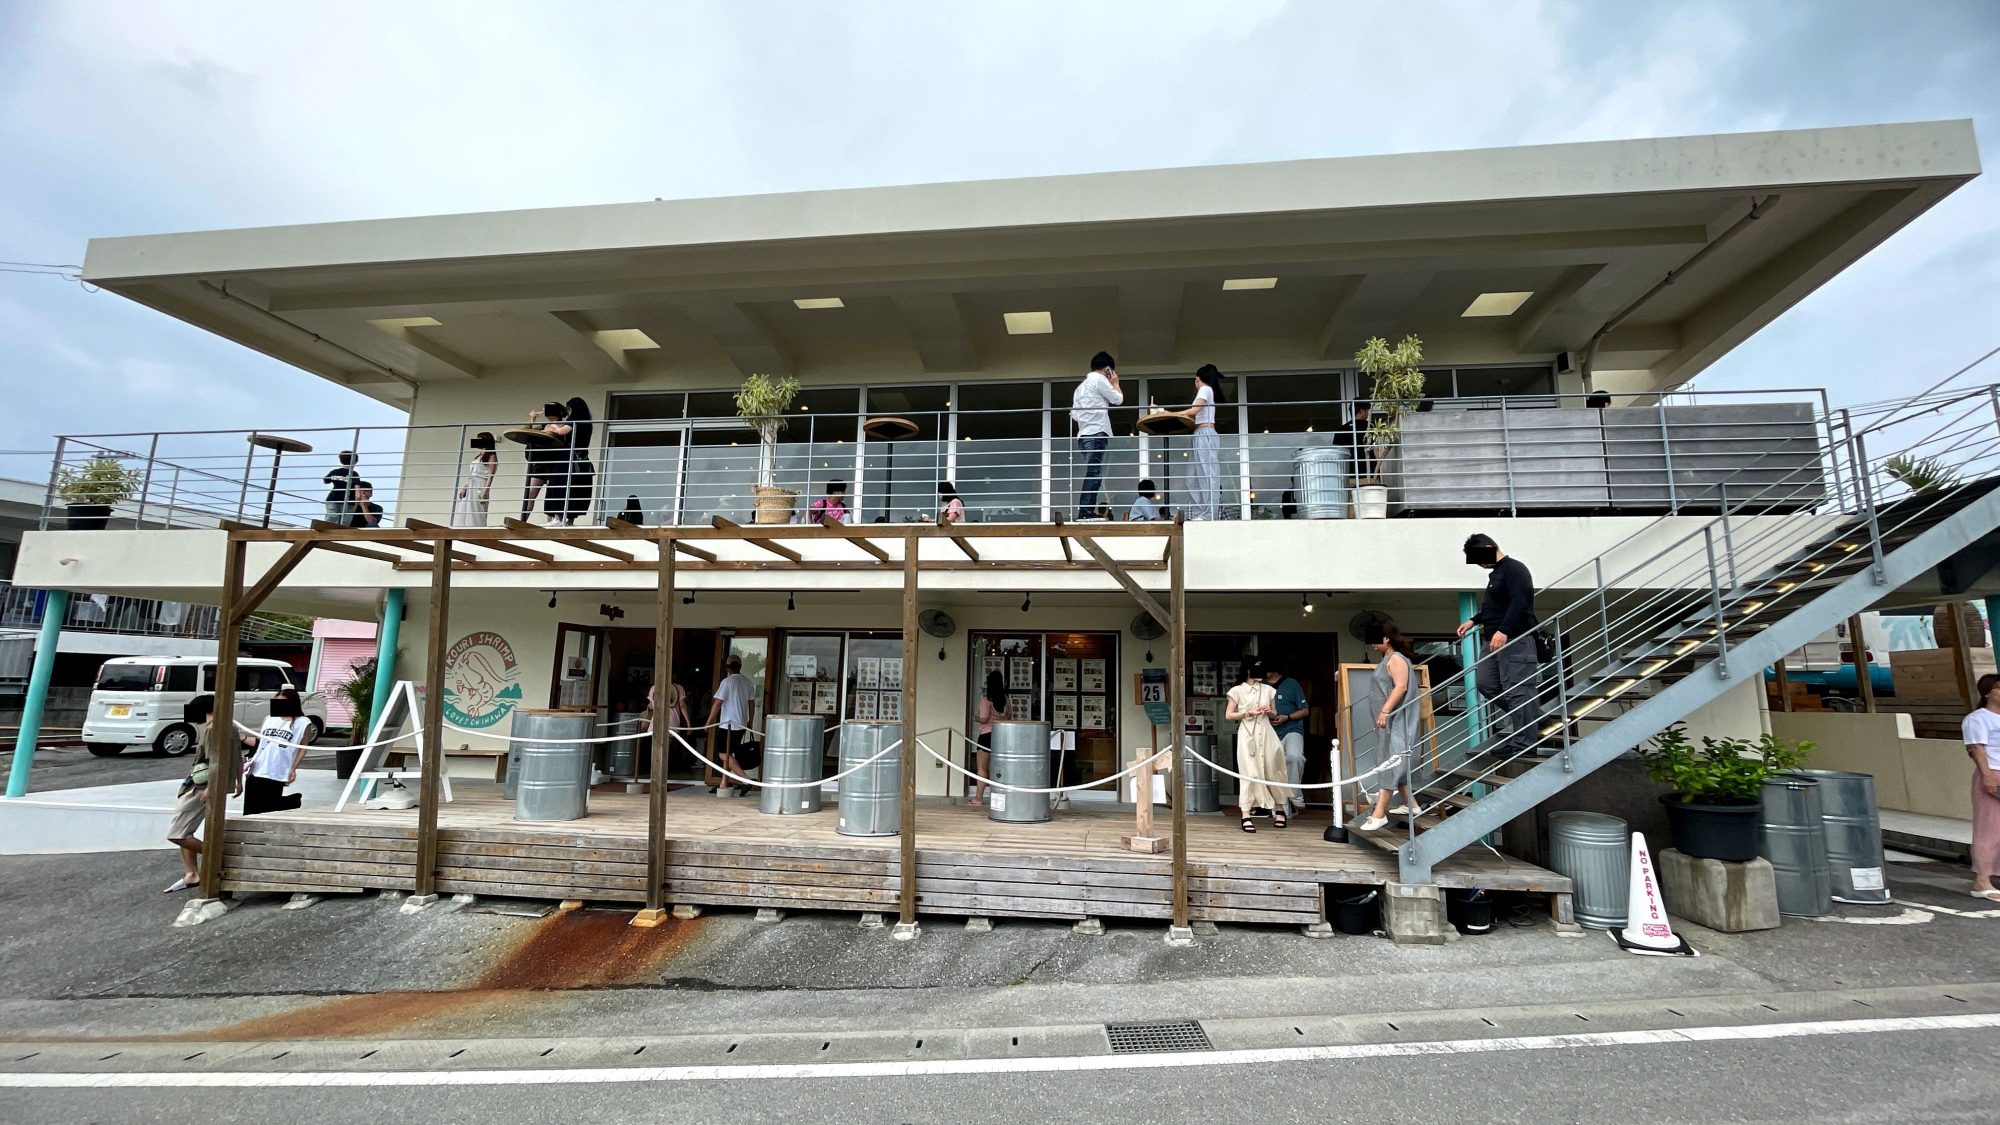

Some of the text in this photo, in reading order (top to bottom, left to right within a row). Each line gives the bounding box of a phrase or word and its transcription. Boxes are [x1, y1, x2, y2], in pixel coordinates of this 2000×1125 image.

[446, 633, 514, 666] KOURI SHRIMP
[1143, 685, 1160, 701] 25
[445, 708, 469, 725] LOVES
[1639, 850, 1647, 865] NO
[1642, 868, 1659, 920] PARKING
